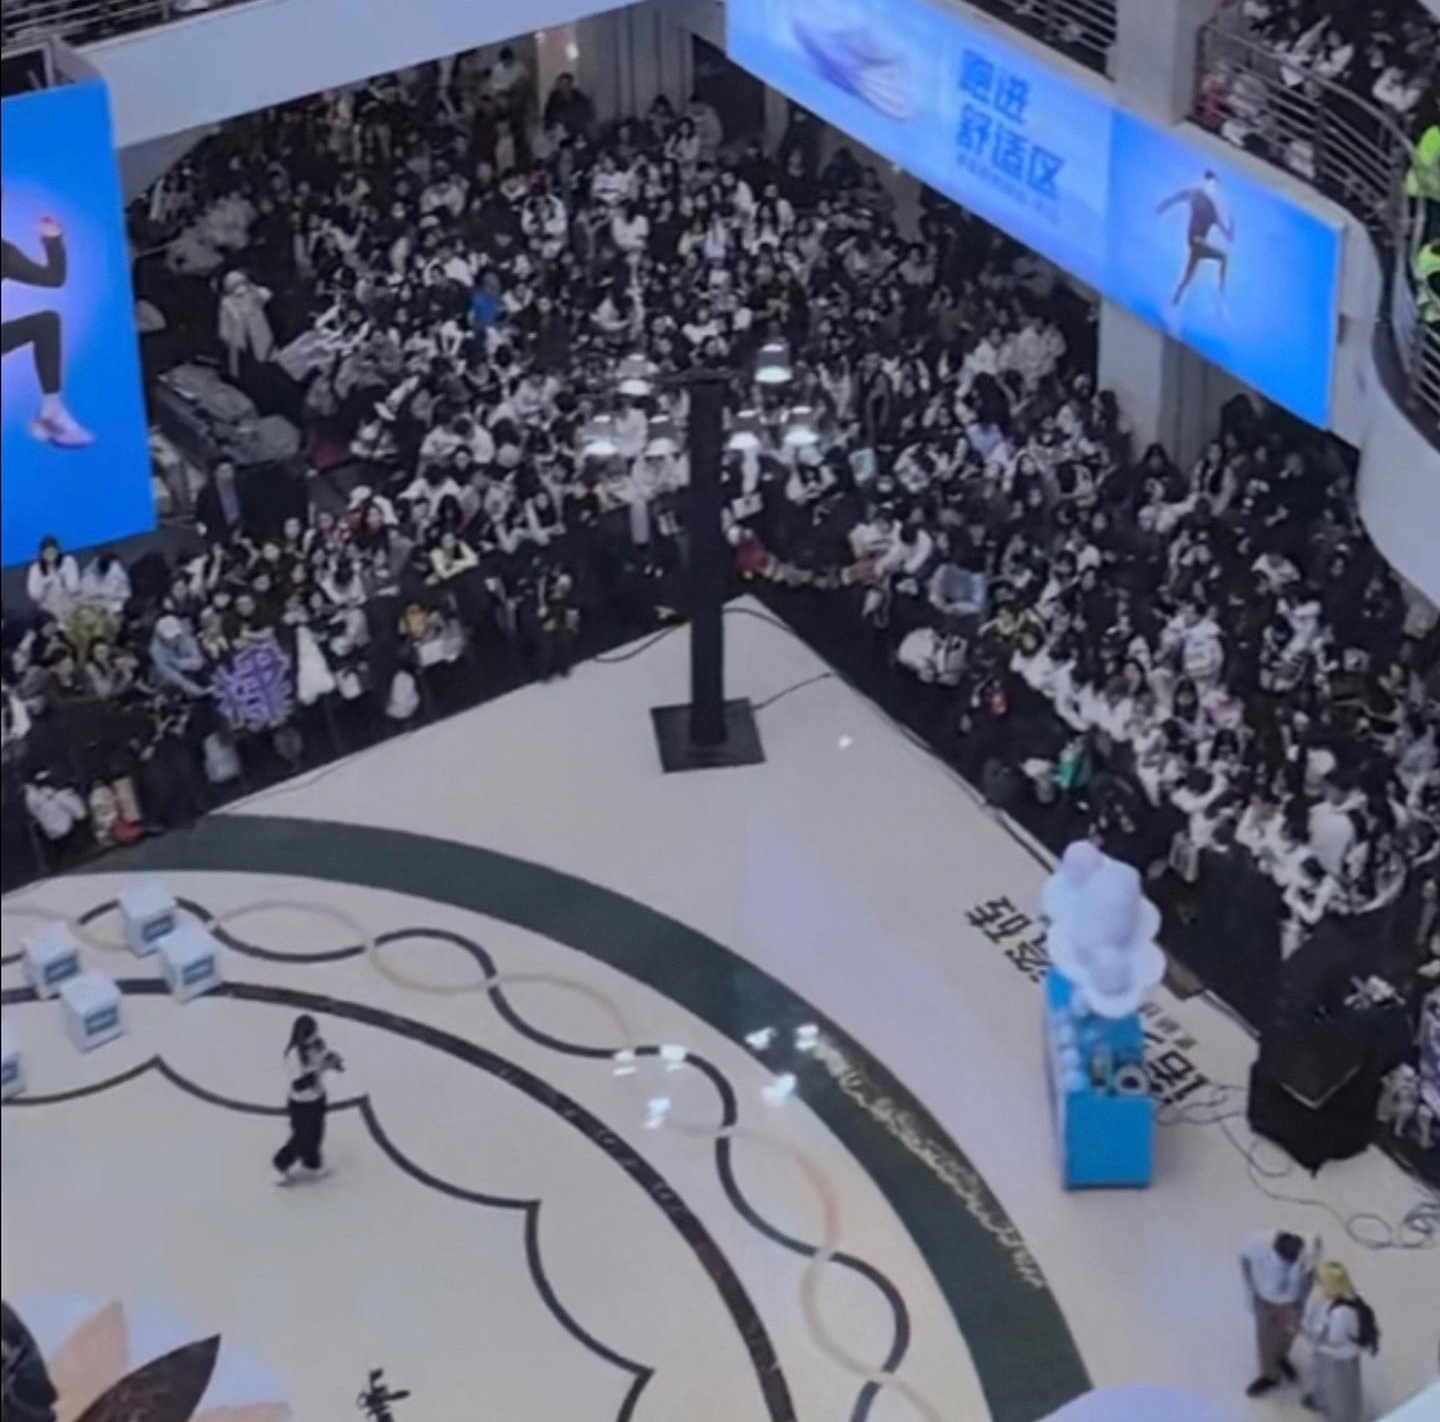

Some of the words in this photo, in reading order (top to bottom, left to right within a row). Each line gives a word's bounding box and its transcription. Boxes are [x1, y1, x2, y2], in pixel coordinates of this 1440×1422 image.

[959, 49, 1028, 125] 跑进
[957, 104, 1066, 200] 舒适区
